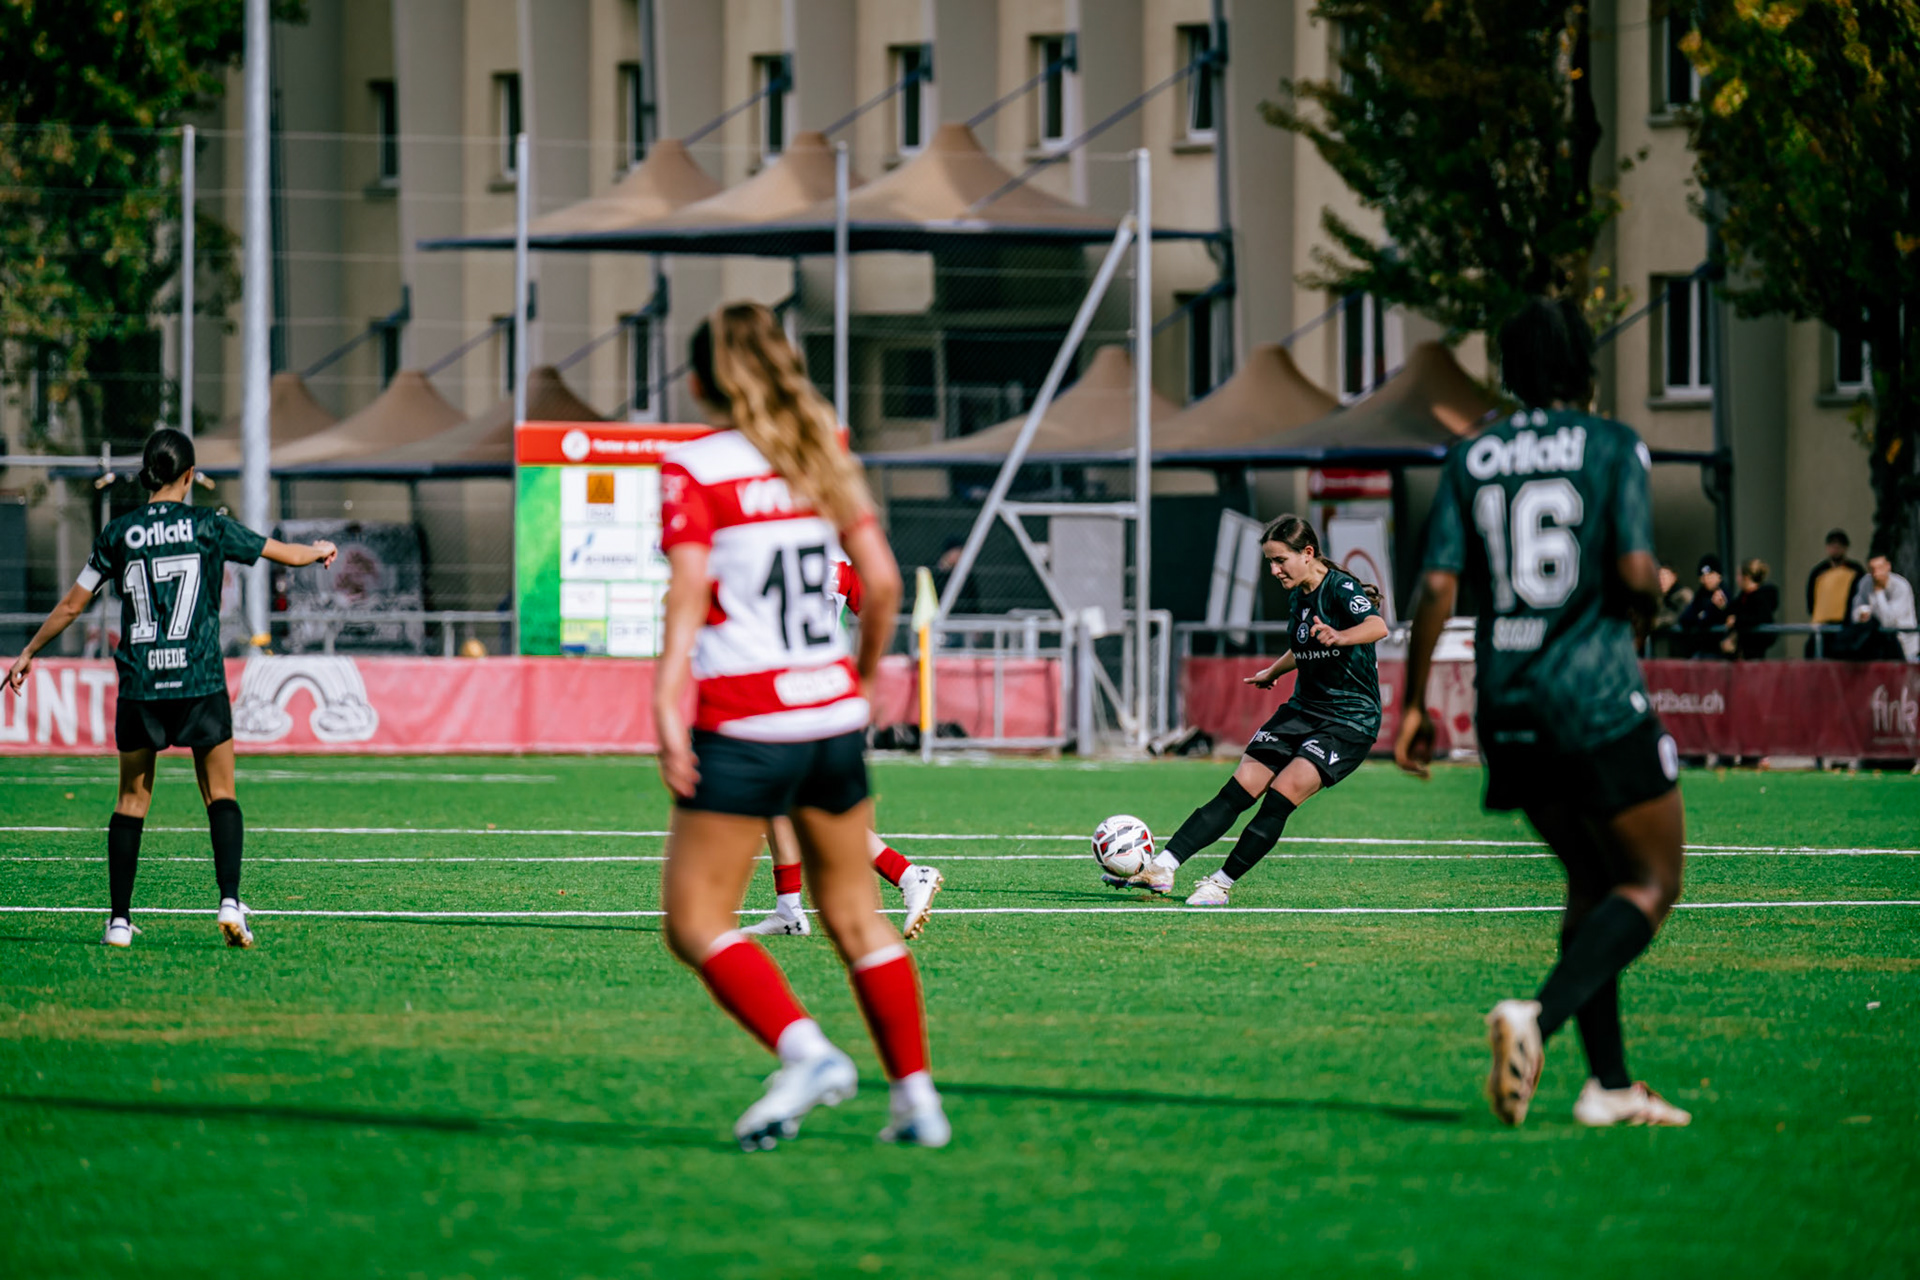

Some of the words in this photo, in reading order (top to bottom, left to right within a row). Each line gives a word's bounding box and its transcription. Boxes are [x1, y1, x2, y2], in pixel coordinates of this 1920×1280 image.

[125, 518, 193, 549] Orllati
[1473, 477, 1584, 612] 16
[123, 553, 200, 645] 17
[148, 648, 188, 671] GUEDE
